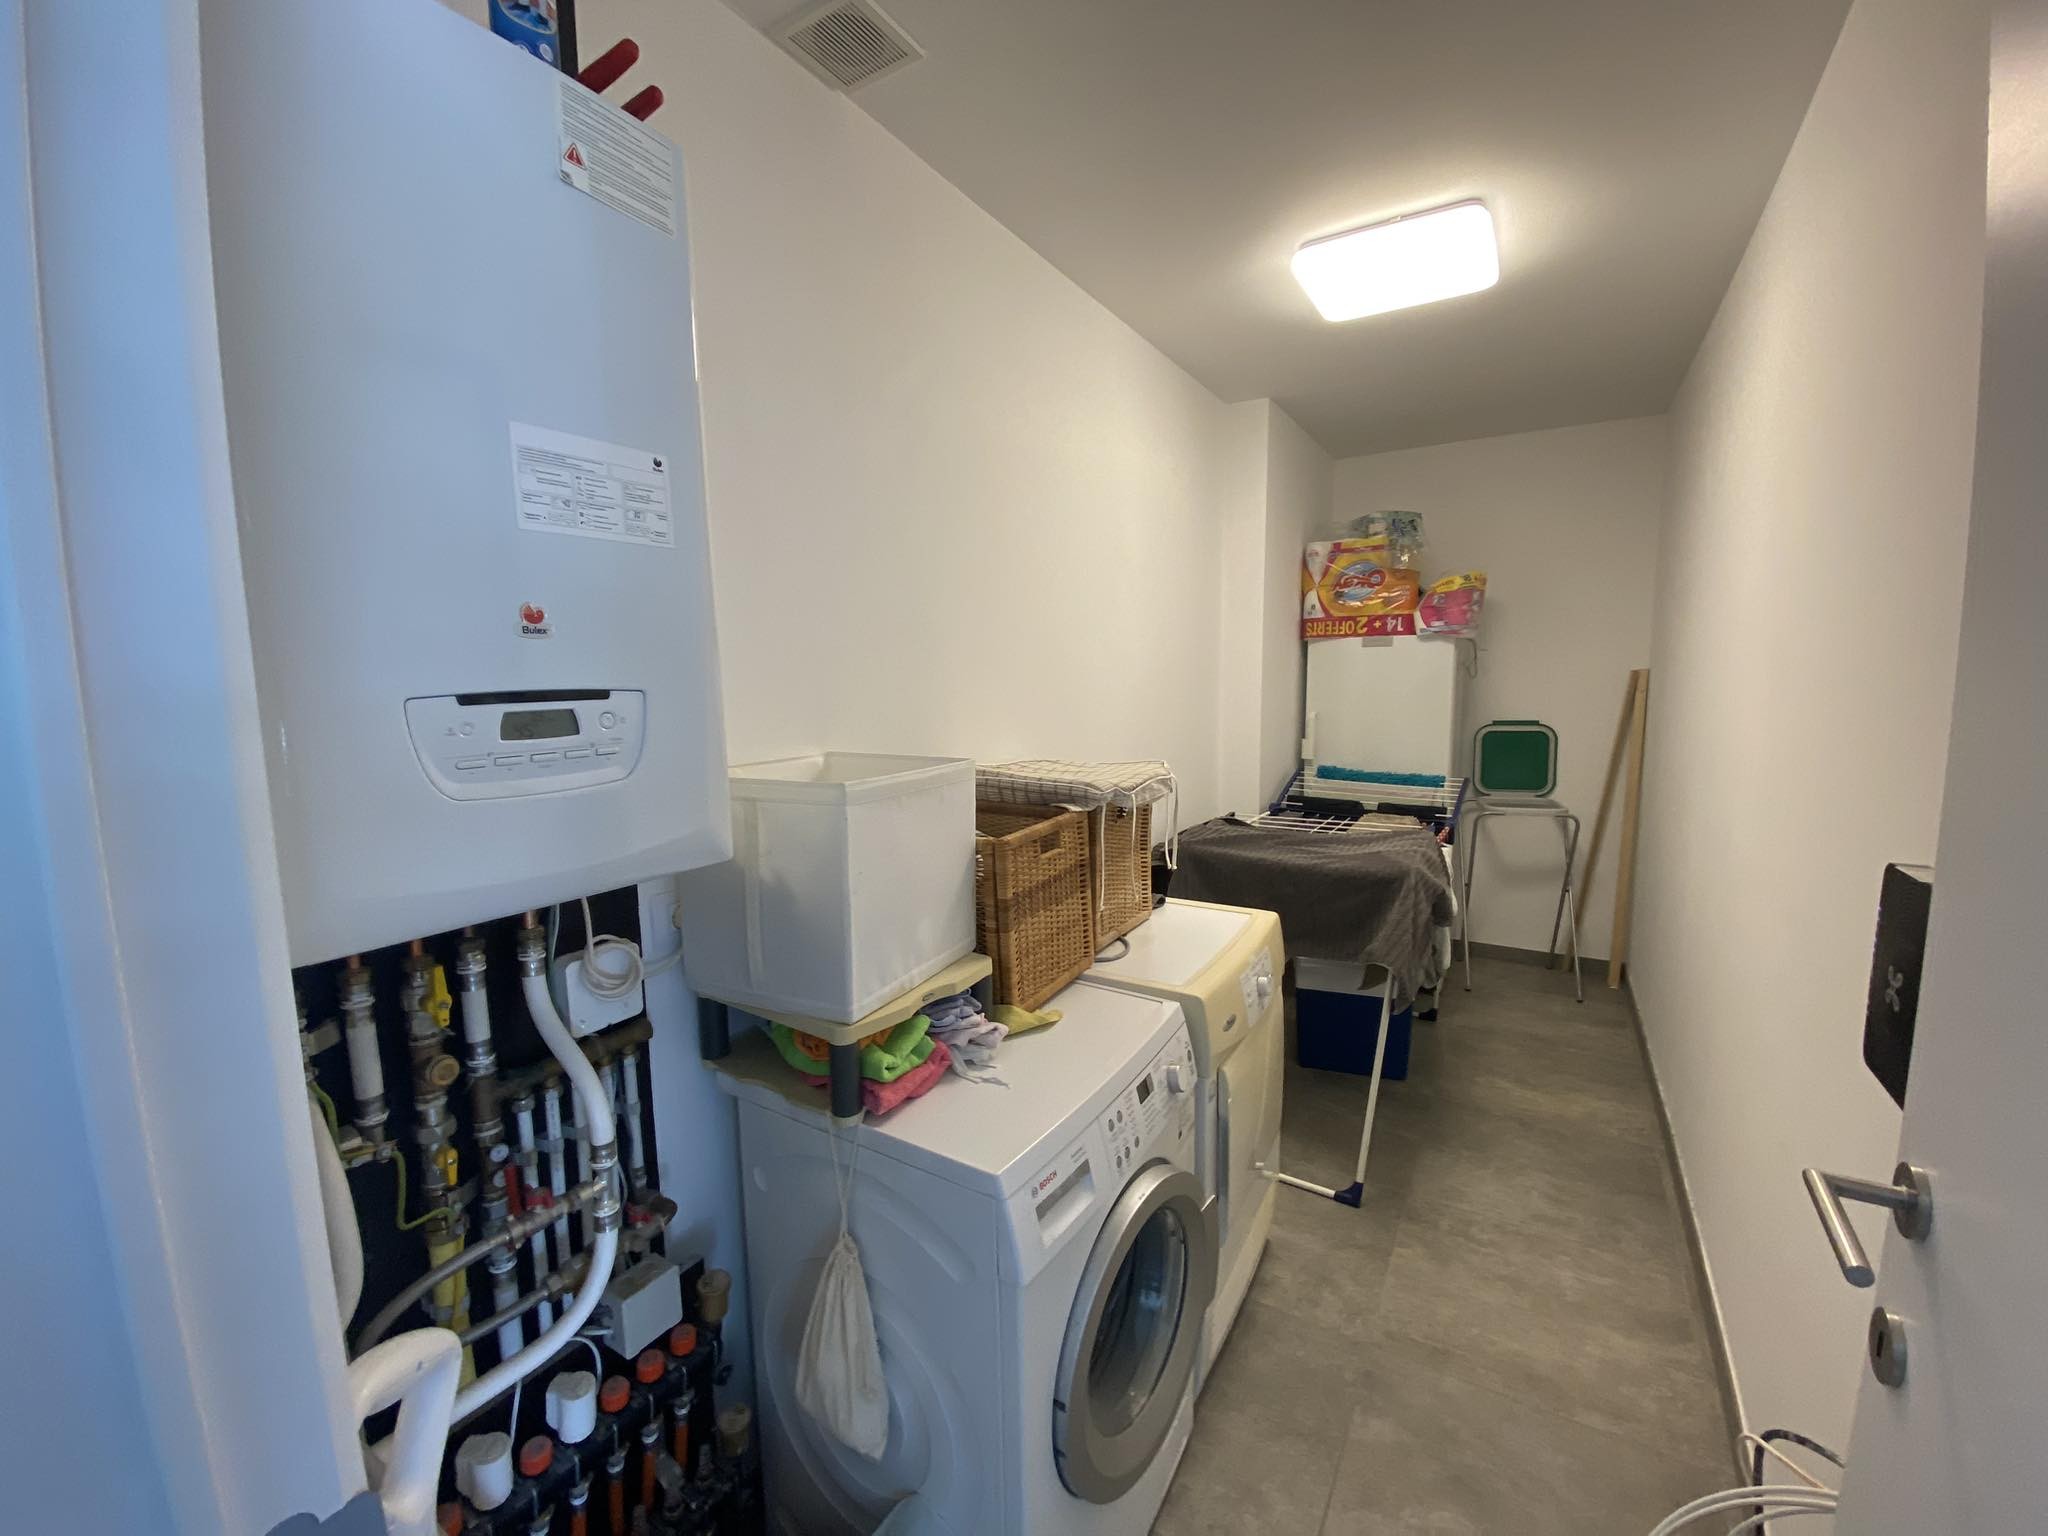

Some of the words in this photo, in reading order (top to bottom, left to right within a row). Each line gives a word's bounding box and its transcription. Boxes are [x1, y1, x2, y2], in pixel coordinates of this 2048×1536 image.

[522, 625, 547, 634] Bulex
[1386, 616, 1404, 633] 14
[1039, 1169, 1058, 1191] BOSCH
